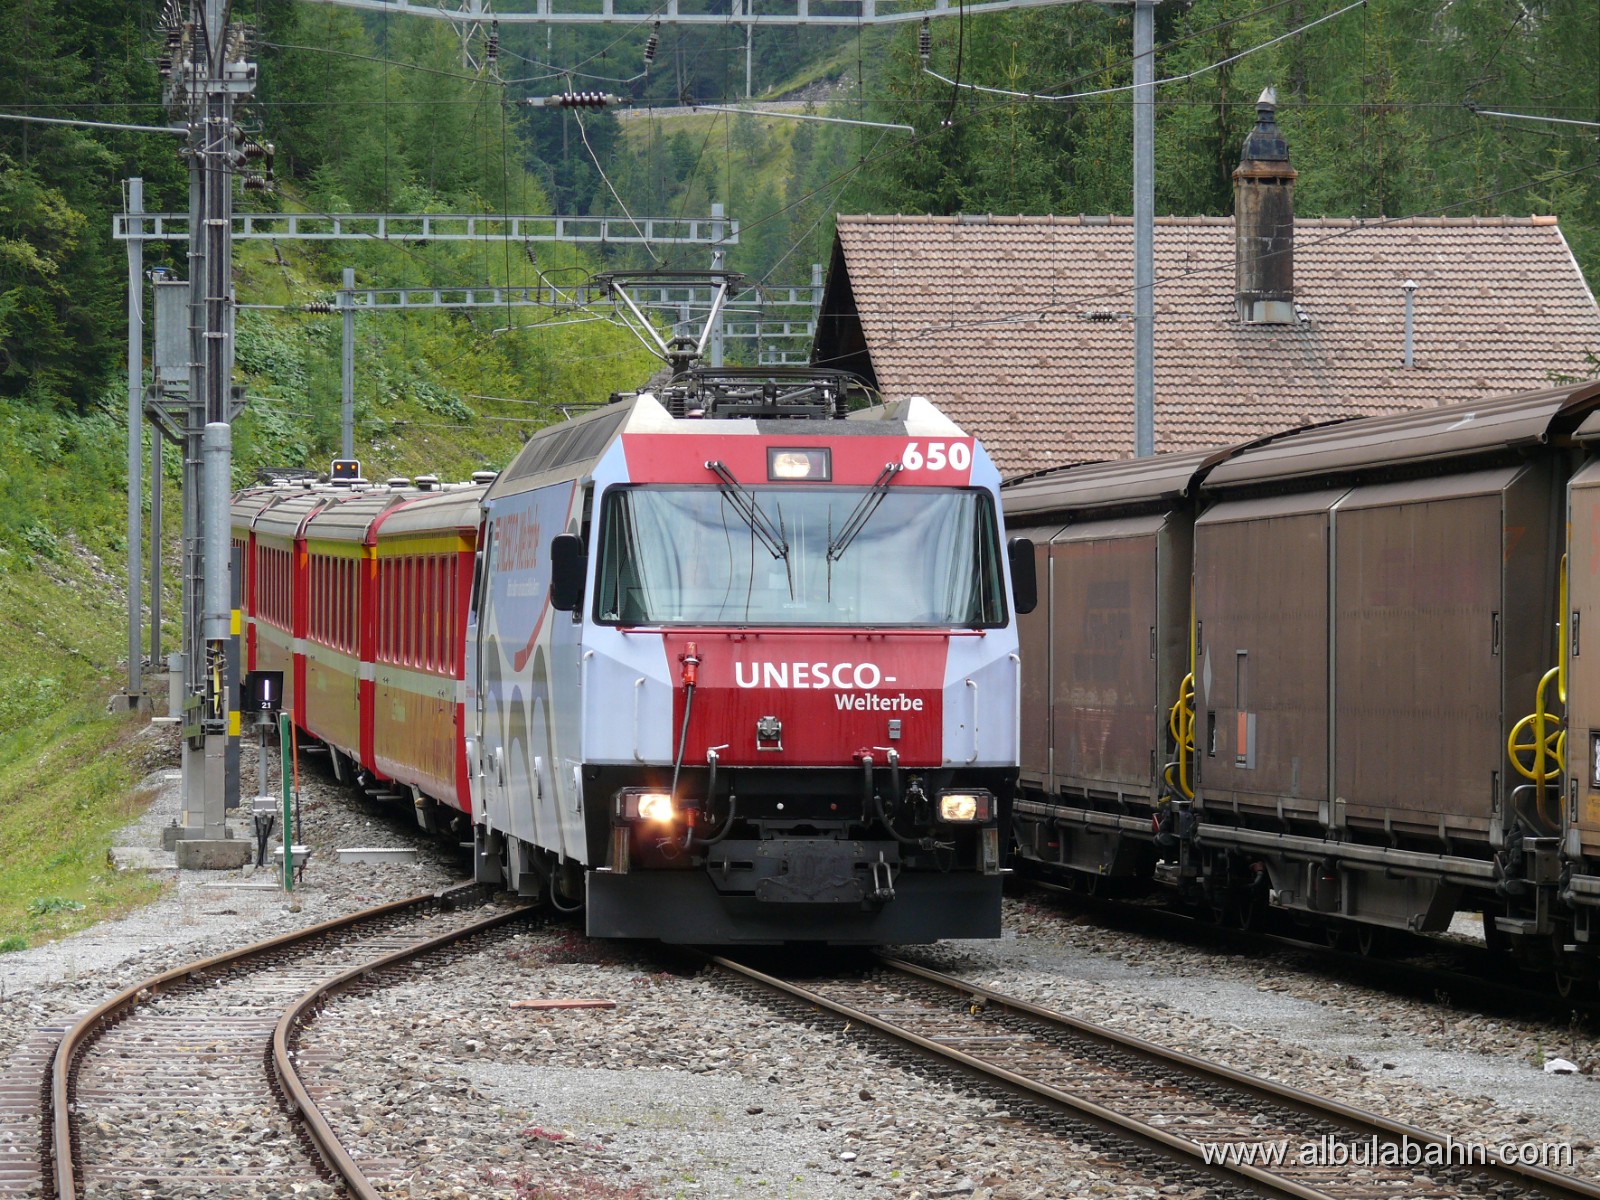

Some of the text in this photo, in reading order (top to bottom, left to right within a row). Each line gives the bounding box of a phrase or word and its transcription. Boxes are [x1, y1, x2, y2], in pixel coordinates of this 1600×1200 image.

[902, 442, 971, 471] 650
[735, 662, 897, 690] UNESCO-
[261, 701, 271, 709] 21
[834, 693, 924, 711] Welterbe
